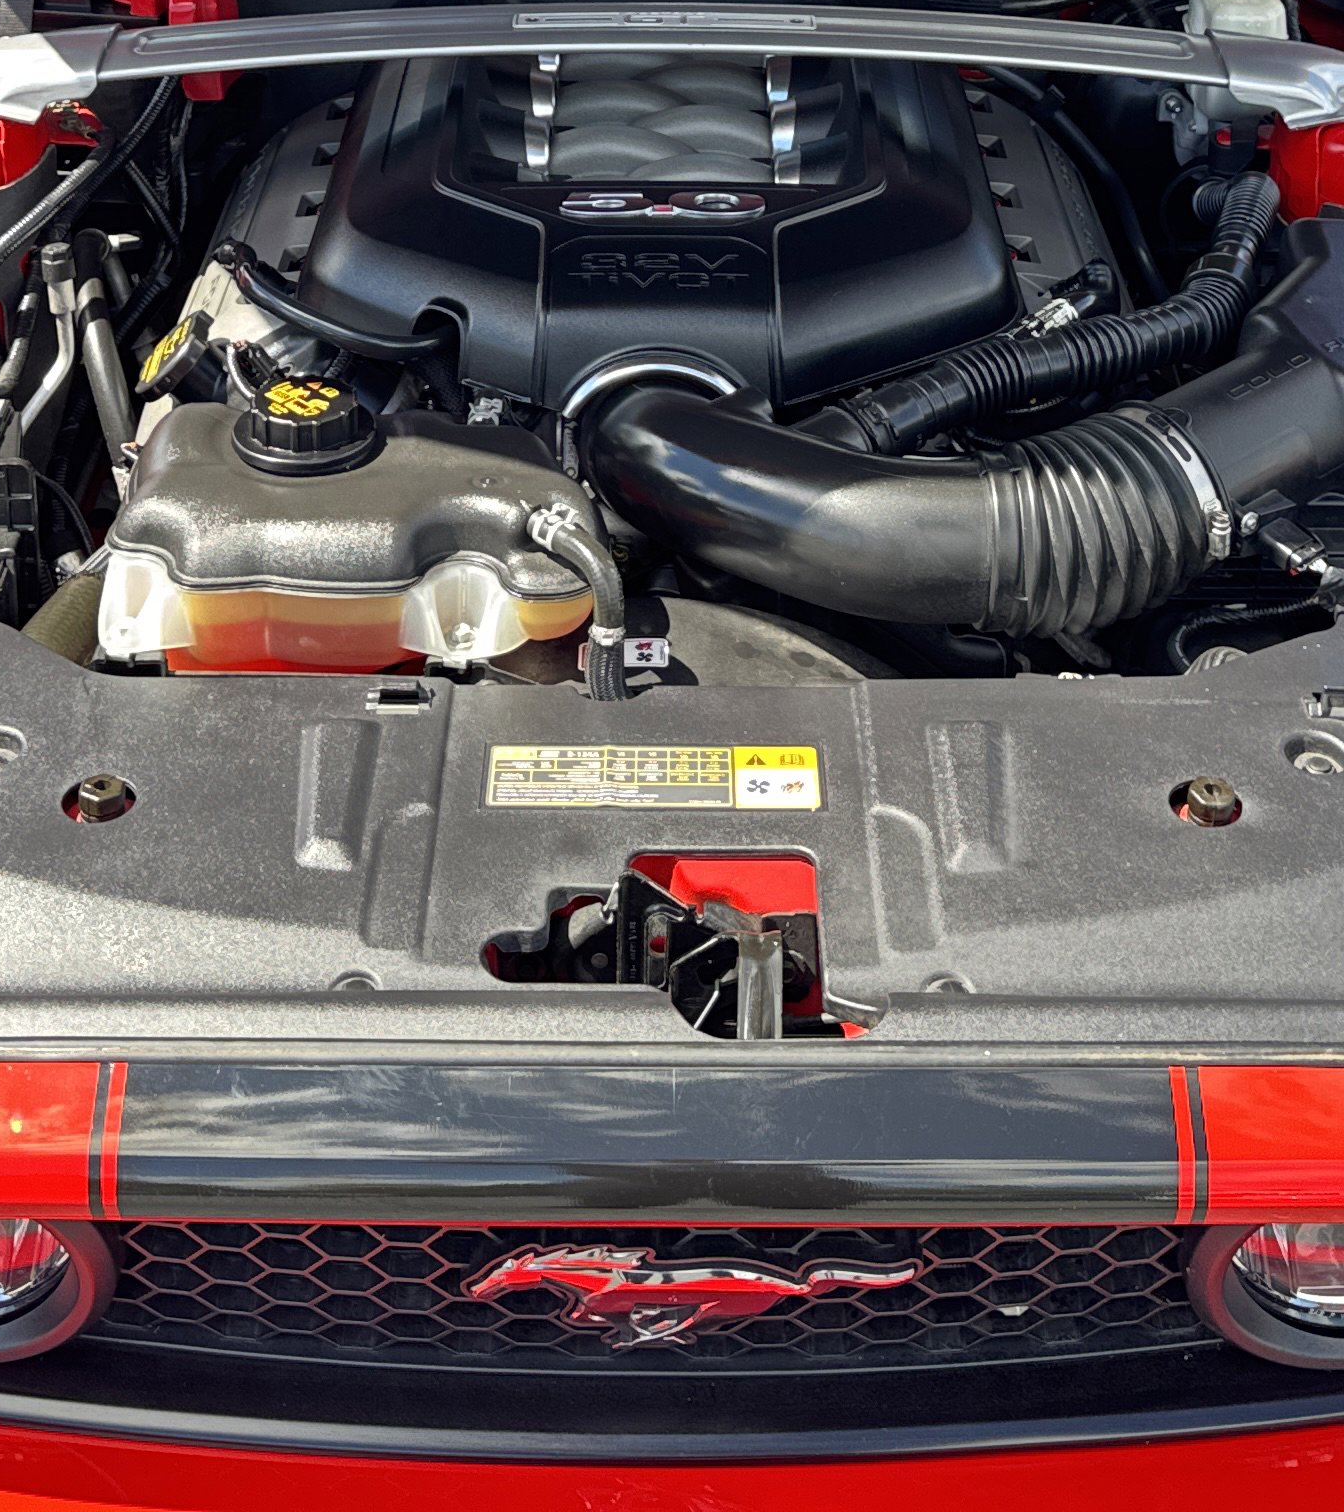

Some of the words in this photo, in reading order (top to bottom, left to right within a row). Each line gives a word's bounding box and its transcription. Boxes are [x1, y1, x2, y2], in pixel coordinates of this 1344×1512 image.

[559, 192, 766, 218] 5.0
[581, 253, 739, 270] 32V
[1226, 354, 1312, 400] COLD
